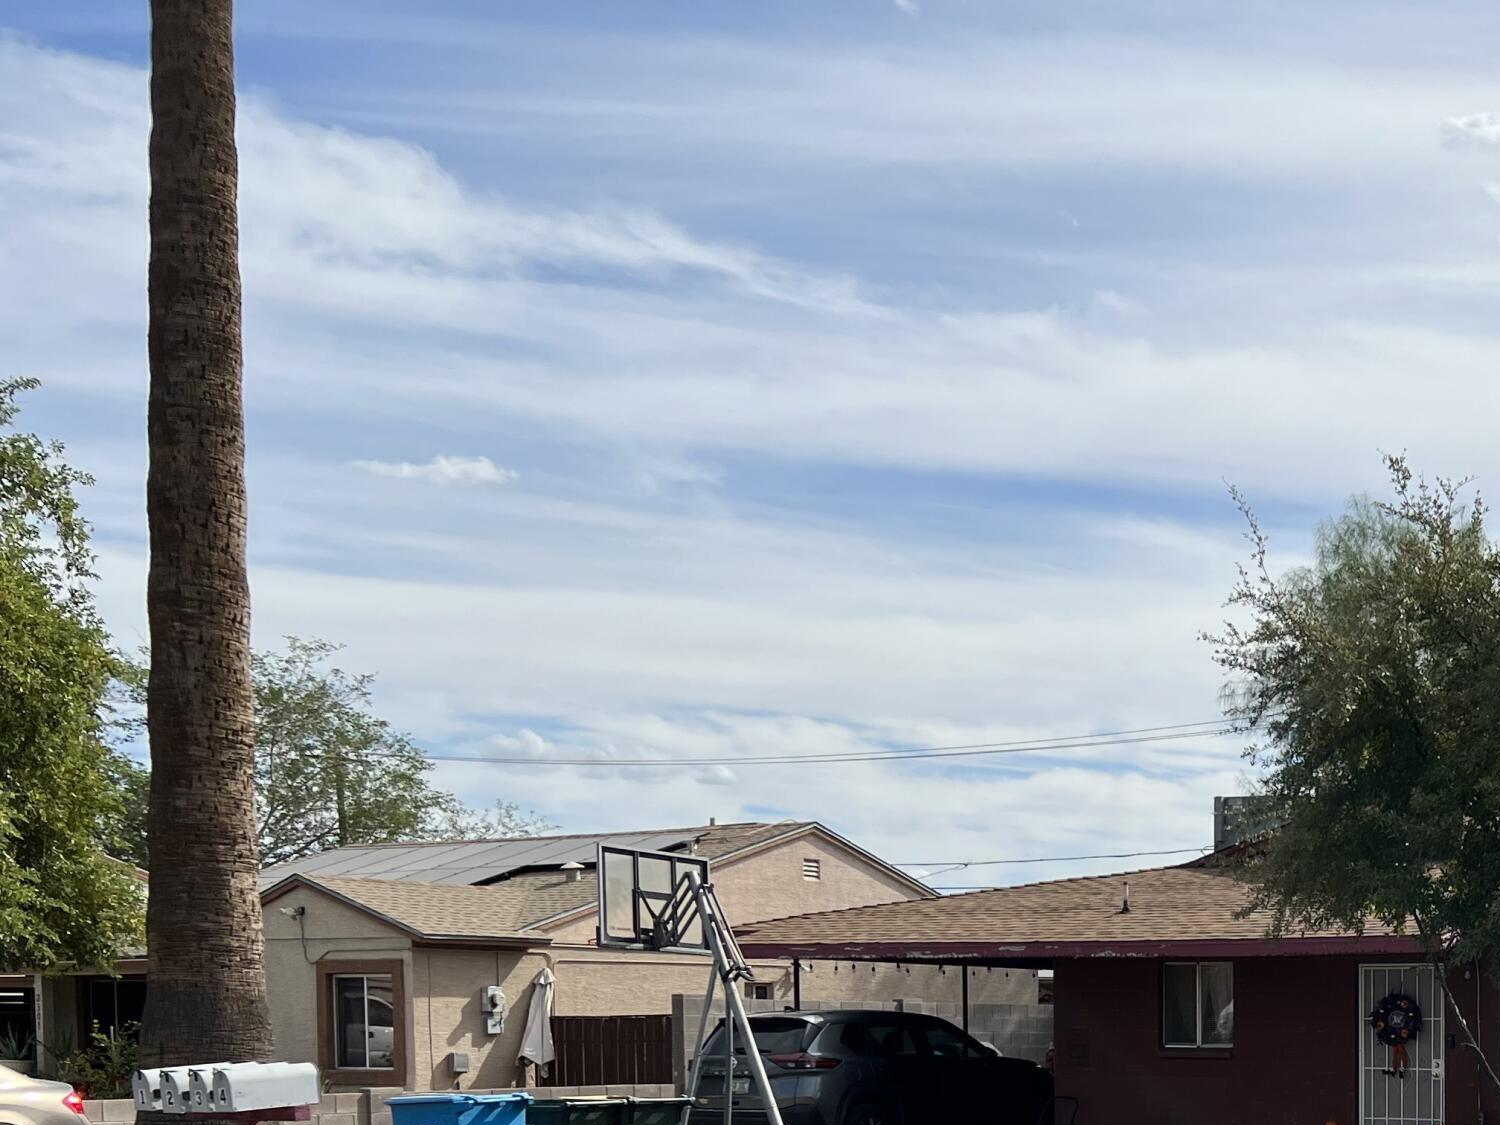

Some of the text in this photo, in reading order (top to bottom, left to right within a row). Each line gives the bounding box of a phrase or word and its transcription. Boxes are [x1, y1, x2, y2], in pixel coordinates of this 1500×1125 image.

[140, 1090, 145, 1104] 1
[166, 1090, 174, 1105] 2
[195, 1091, 202, 1106] 3
[220, 1089, 226, 1104] 4
